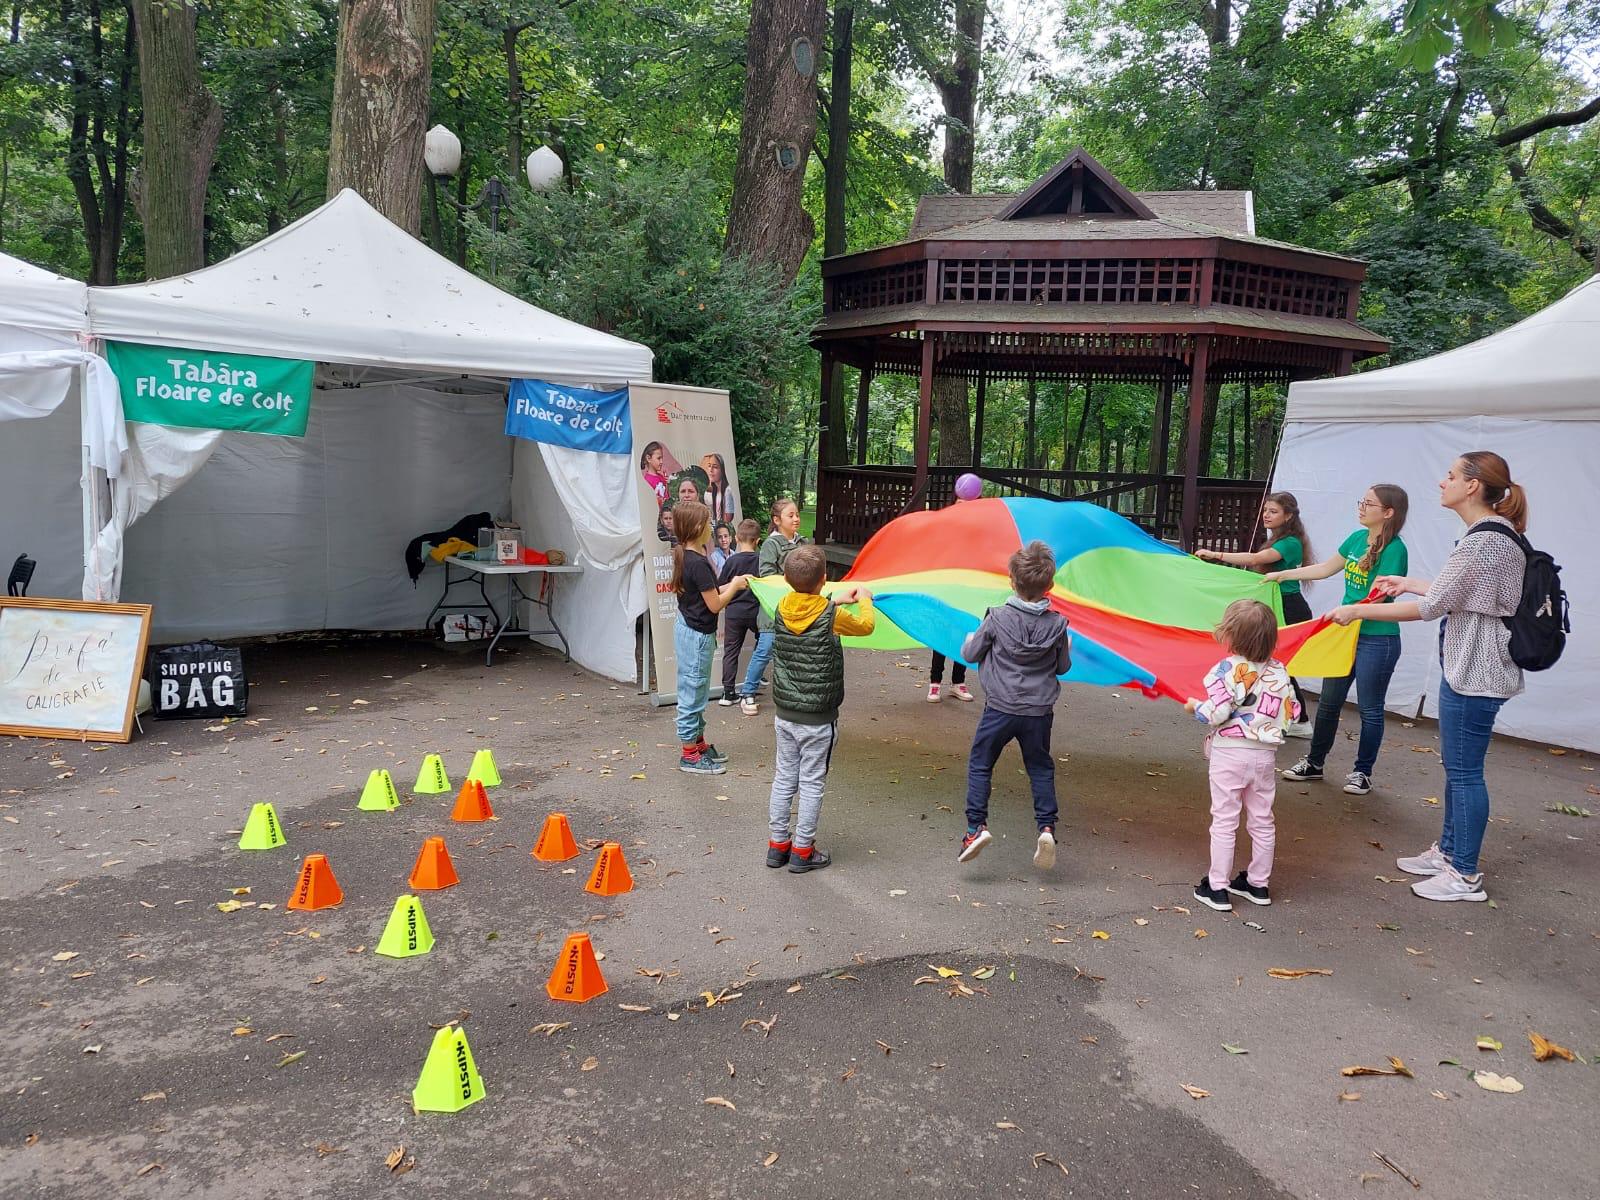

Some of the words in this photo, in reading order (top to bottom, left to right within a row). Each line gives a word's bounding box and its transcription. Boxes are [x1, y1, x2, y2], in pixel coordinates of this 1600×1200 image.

[136, 376, 212, 403] Floare
[218, 388, 245, 407] de
[516, 398, 564, 425] Floare
[569, 414, 589, 431] de
[656, 583, 673, 593] CAS
[161, 661, 232, 676] SHOPPING
[26, 676, 105, 710] CALIGRAFIE
[160, 675, 235, 710] BAG
